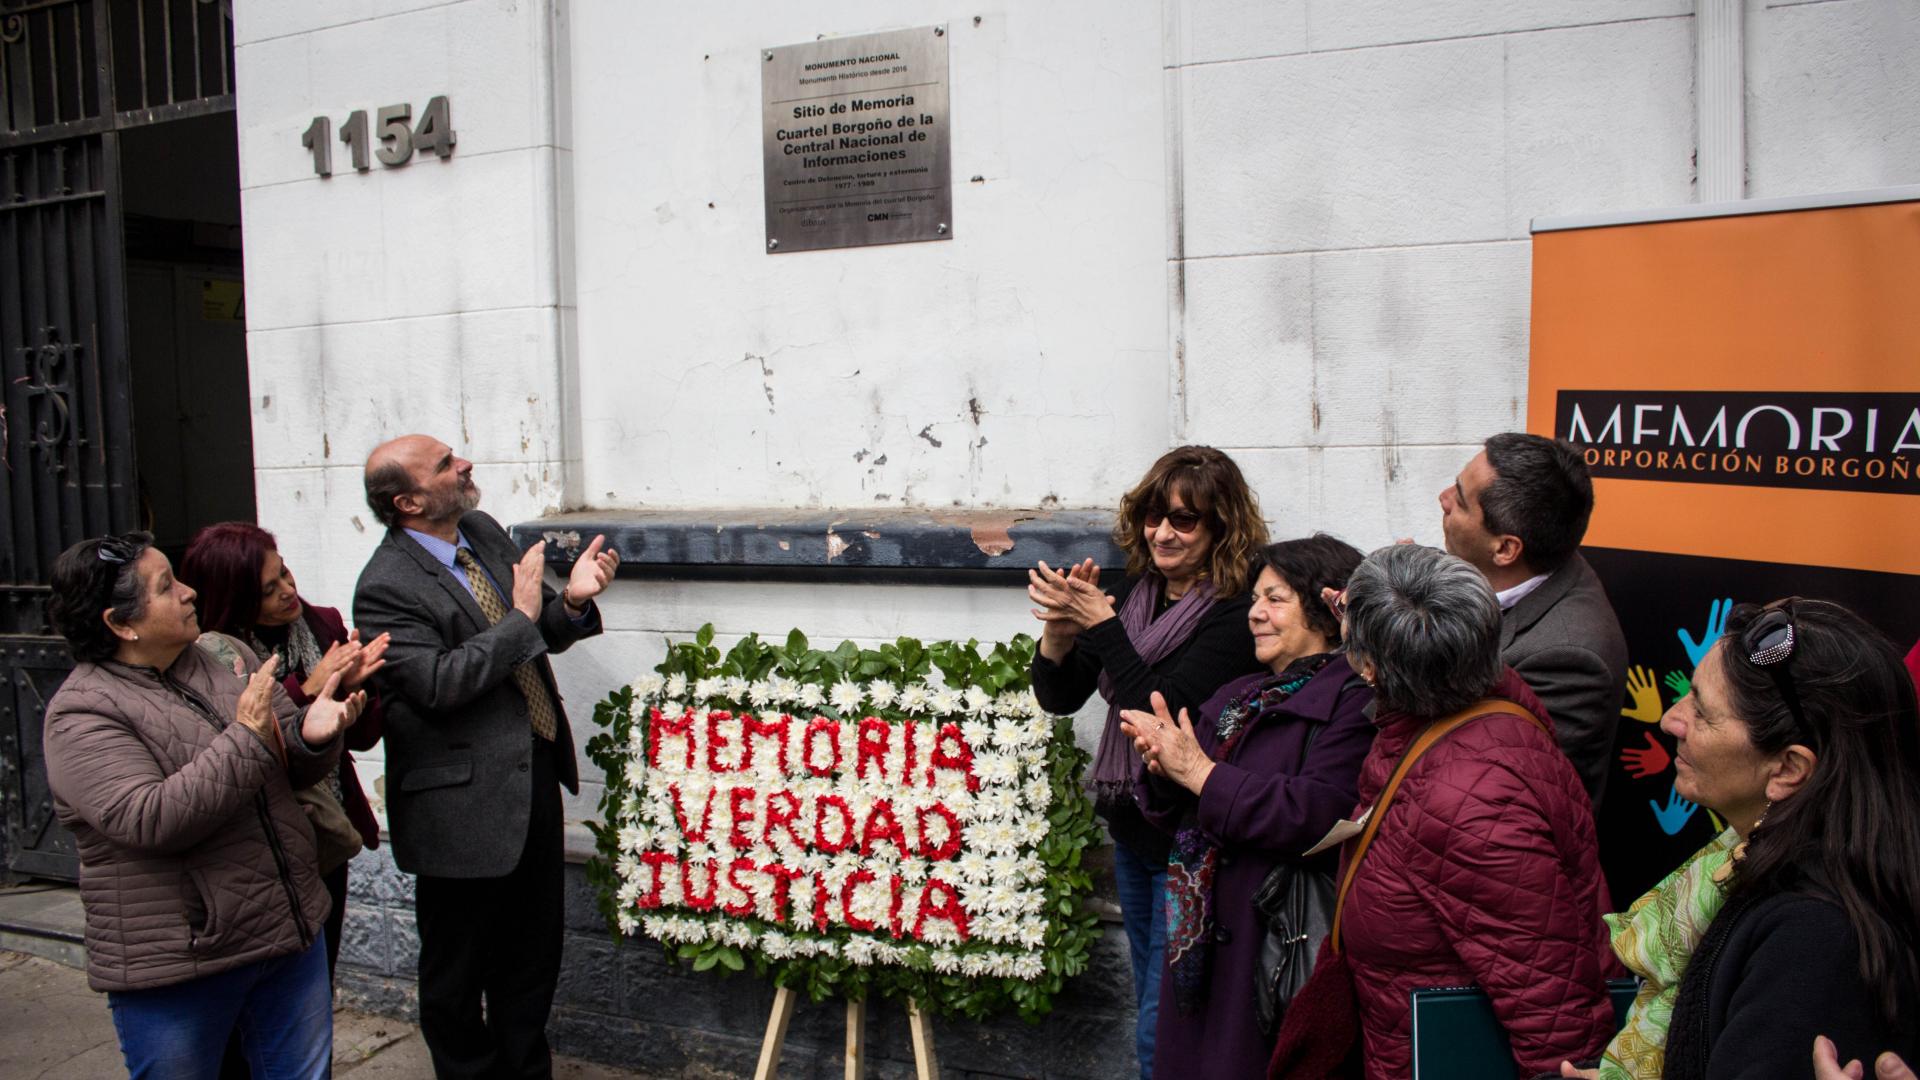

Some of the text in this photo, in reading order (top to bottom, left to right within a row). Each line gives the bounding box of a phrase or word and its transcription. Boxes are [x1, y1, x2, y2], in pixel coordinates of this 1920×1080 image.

[804, 52, 901, 71] MONUMENTO NACIONAL
[799, 75, 837, 86] Monumento
[838, 70, 868, 81] Histórico
[870, 67, 891, 77] desde
[793, 94, 915, 119] Sitio de Memoria
[301, 95, 457, 178] 1154
[776, 113, 934, 141] Cuartel Borgoño de la
[783, 130, 927, 156] Central Nacional de
[803, 149, 907, 169] Informaciones
[783, 178, 806, 187] Centro
[856, 171, 882, 179] tortura
[889, 166, 929, 176] exterminio
[867, 212, 889, 222] CMN
[1568, 402, 1920, 454] MEMORIA
[1583, 447, 1920, 481] ORPORACIÓN BORGOÑ
[650, 705, 981, 793] MEMORIA
[669, 781, 963, 862] VERDAD
[637, 850, 972, 942] JUSTICIA
